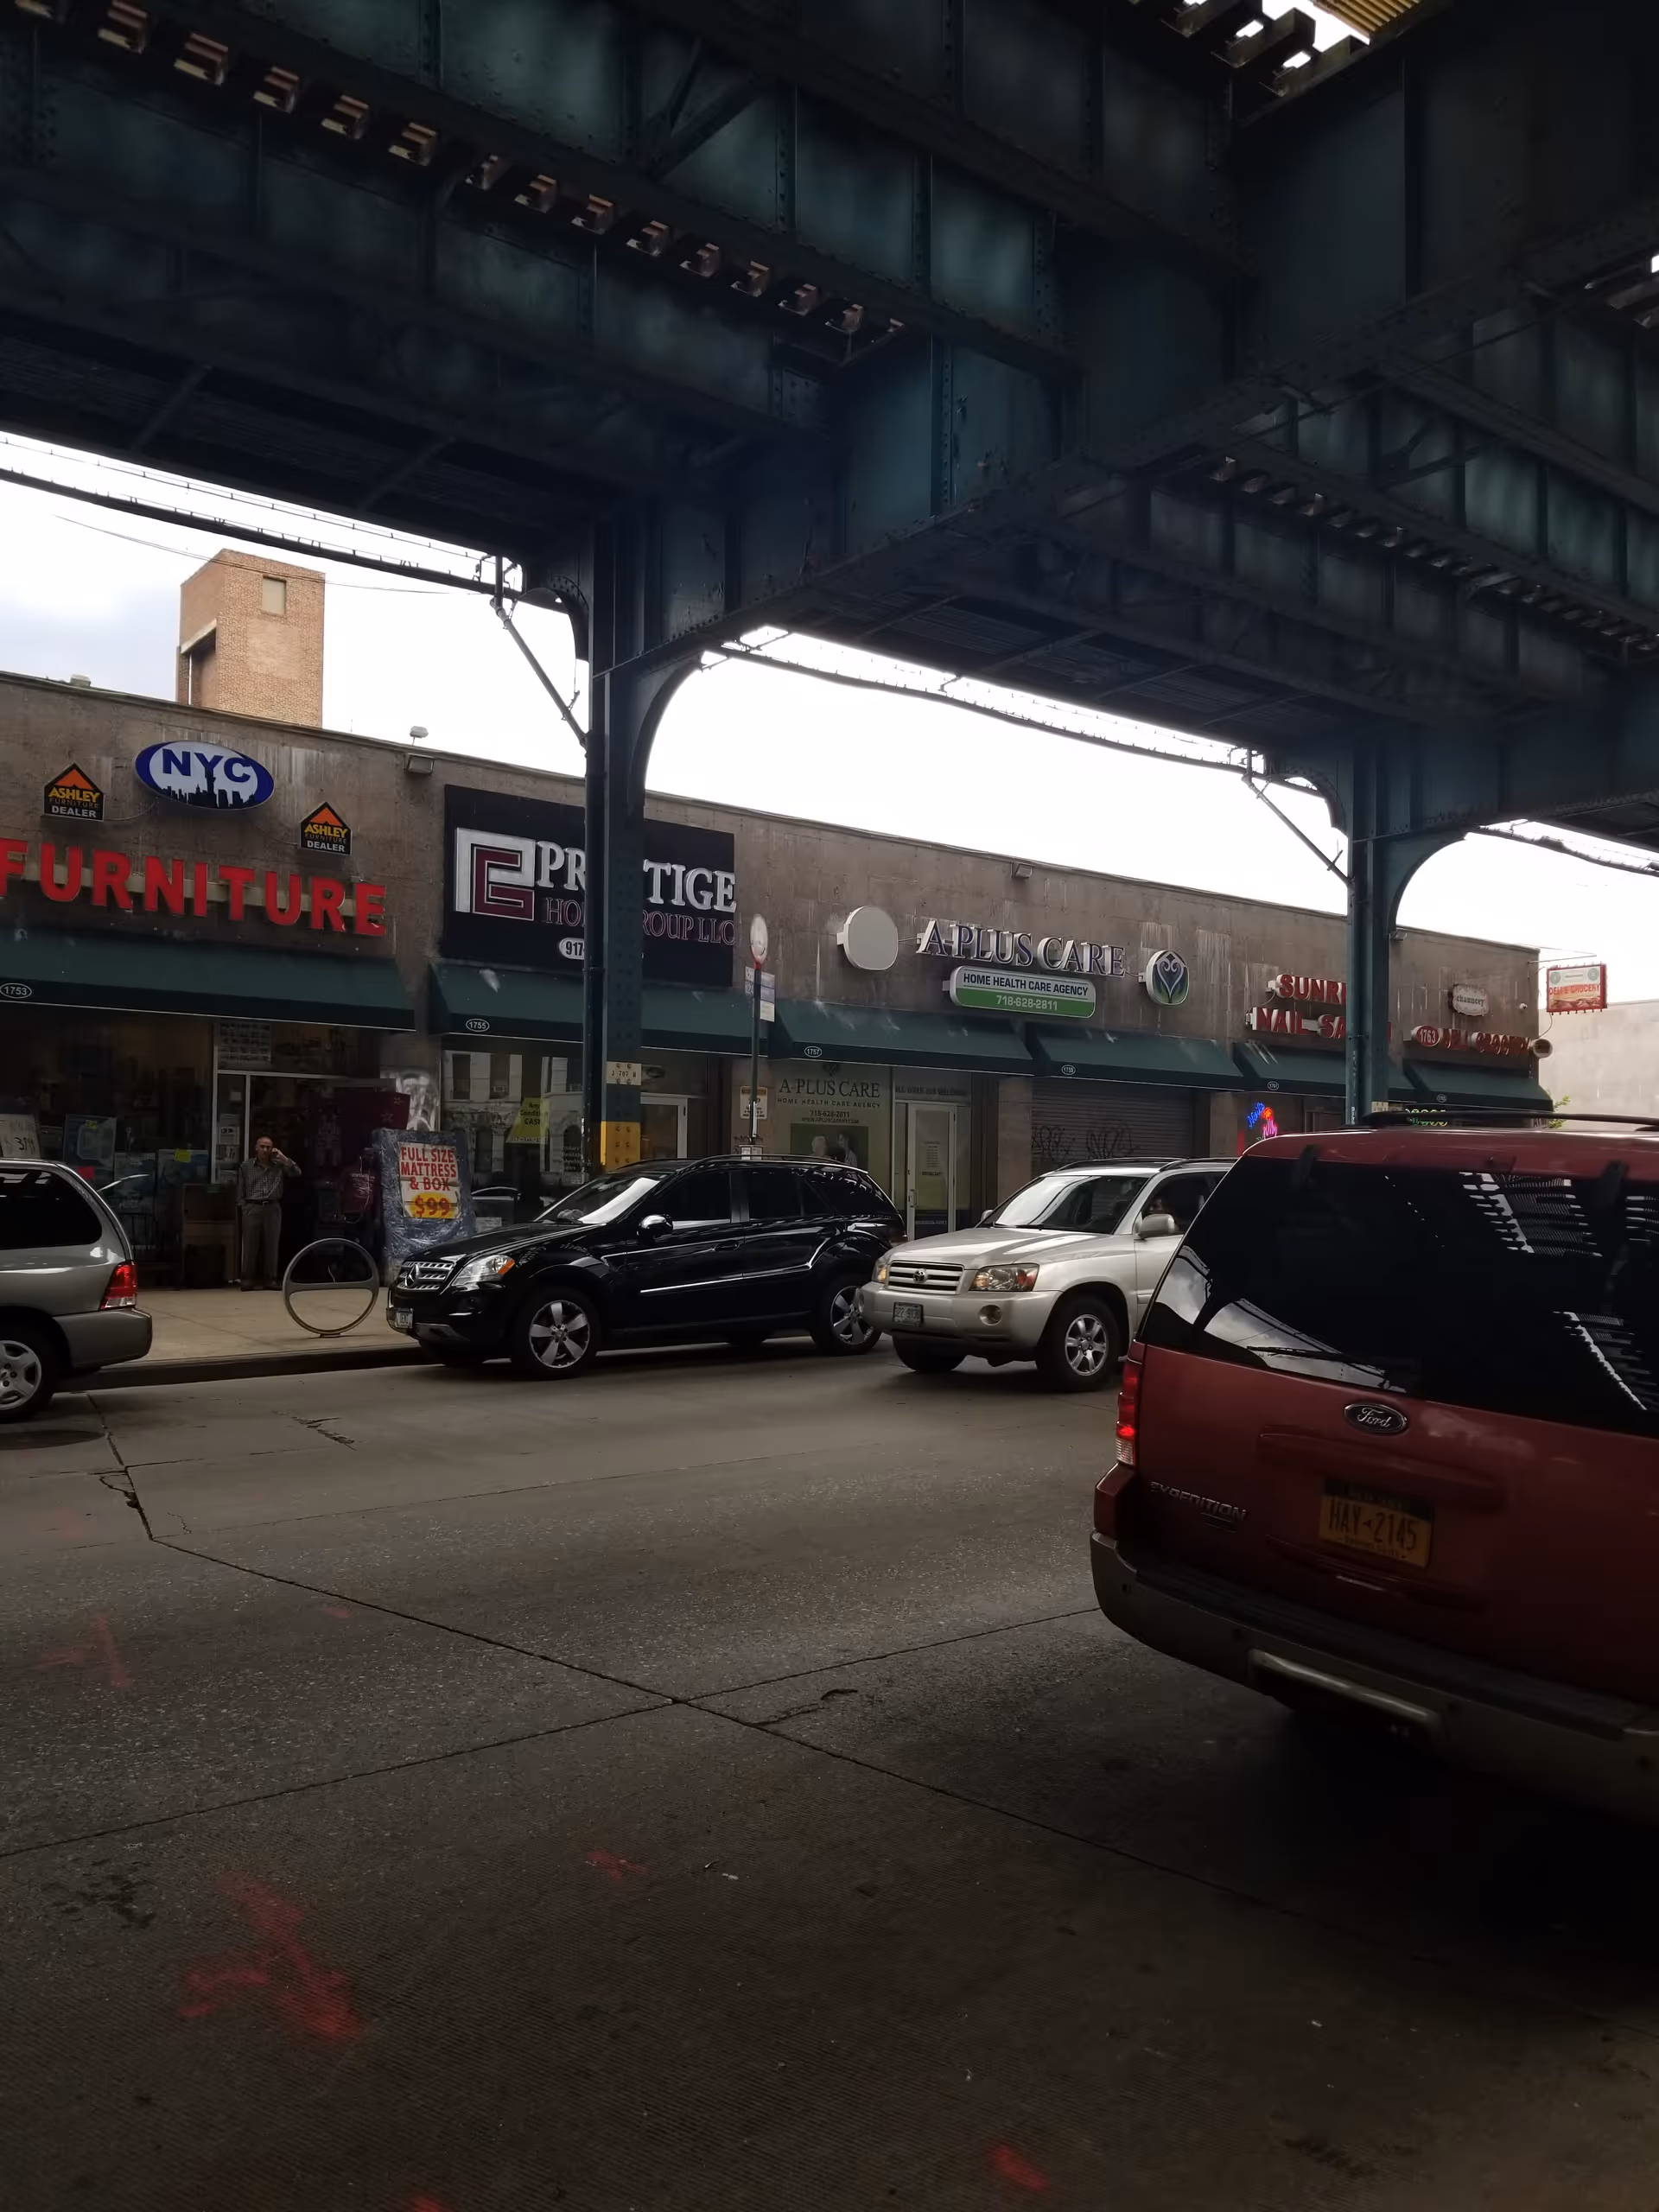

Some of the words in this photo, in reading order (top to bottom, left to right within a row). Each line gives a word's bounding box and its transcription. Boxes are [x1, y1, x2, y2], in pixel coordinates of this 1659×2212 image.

[162, 748, 251, 783] NYC
[48, 785, 100, 802] ASHLEY
[52, 804, 97, 818] DEALER
[304, 823, 348, 838] ASHLEY
[307, 839, 346, 853] DEALER
[537, 841, 736, 913] PRTIGE
[0, 837, 385, 937] FURNITURE
[1038, 936, 1124, 978] CARE
[3, 986, 27, 995] 1753
[963, 973, 991, 985] HOME
[993, 976, 1027, 990] HEALTH
[1028, 981, 1052, 993] CARE
[1053, 984, 1089, 996] AGENCY
[996, 995, 1058, 1011] 718-628-2811
[1252, 1007, 1311, 1035] NAIL
[1419, 1029, 1436, 1045] 1763
[779, 1078, 836, 1096] A-PLUS
[839, 1081, 880, 1098] CARE
[400, 1146, 429, 1161] FULL
[430, 1149, 454, 1163] SIZE
[400, 1162, 457, 1178] MATTRESS
[410, 1177, 419, 1190] &
[423, 1178, 450, 1191] BOX
[415, 1195, 452, 1217] $99
[1357, 1407, 1392, 1428] Ford
[1150, 1480, 1249, 1522] EXPEDITION
